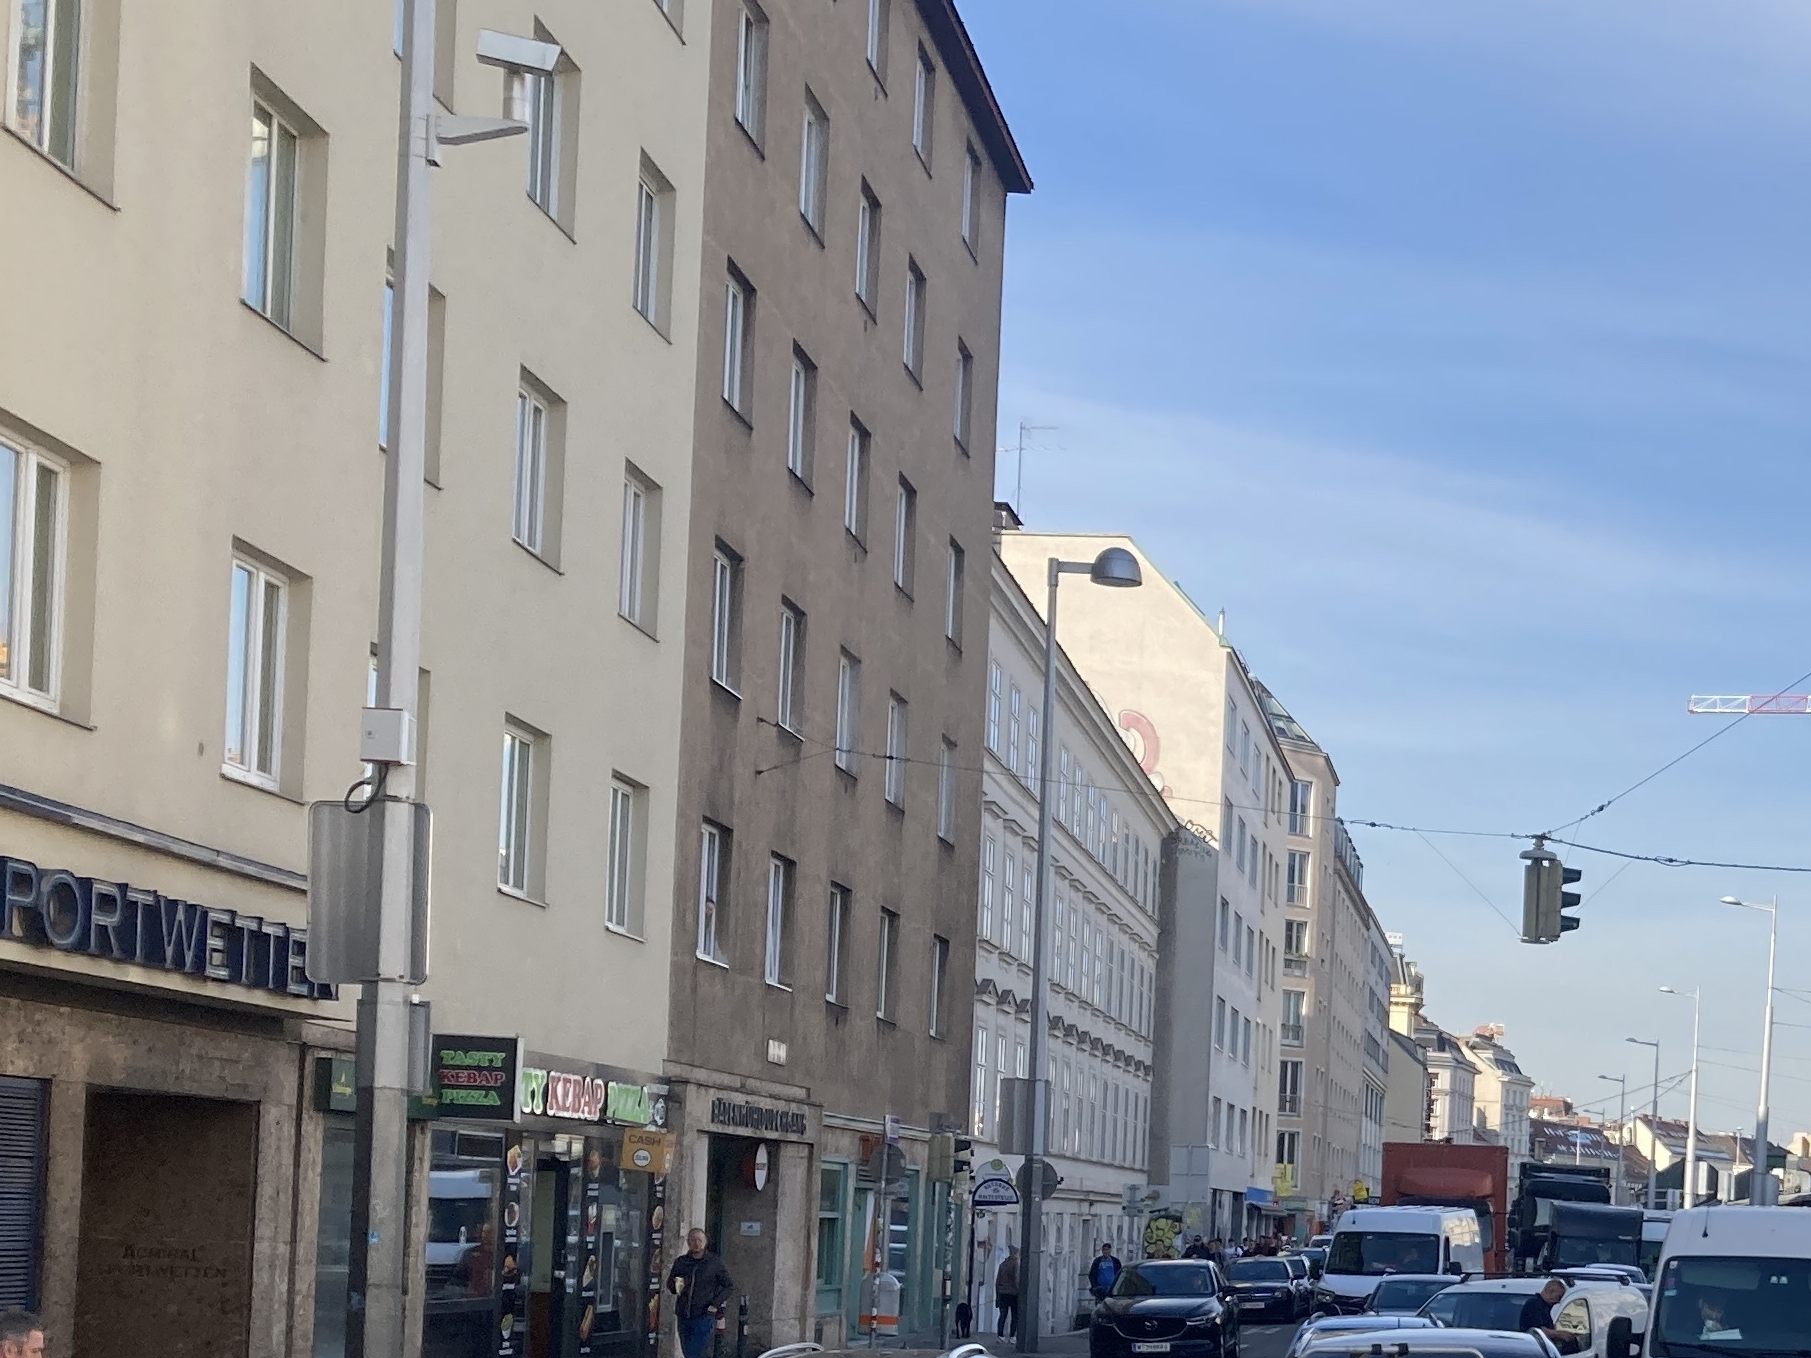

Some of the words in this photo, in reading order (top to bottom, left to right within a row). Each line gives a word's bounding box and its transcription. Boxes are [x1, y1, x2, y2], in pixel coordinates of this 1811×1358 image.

[3, 857, 339, 1001] PORTWETTE
[439, 1050, 506, 1068] TASTY
[438, 1068, 506, 1087] KEBAP
[441, 1088, 501, 1106] PIZZA
[546, 1070, 605, 1122] KEBAP
[628, 1133, 662, 1148] CASH
